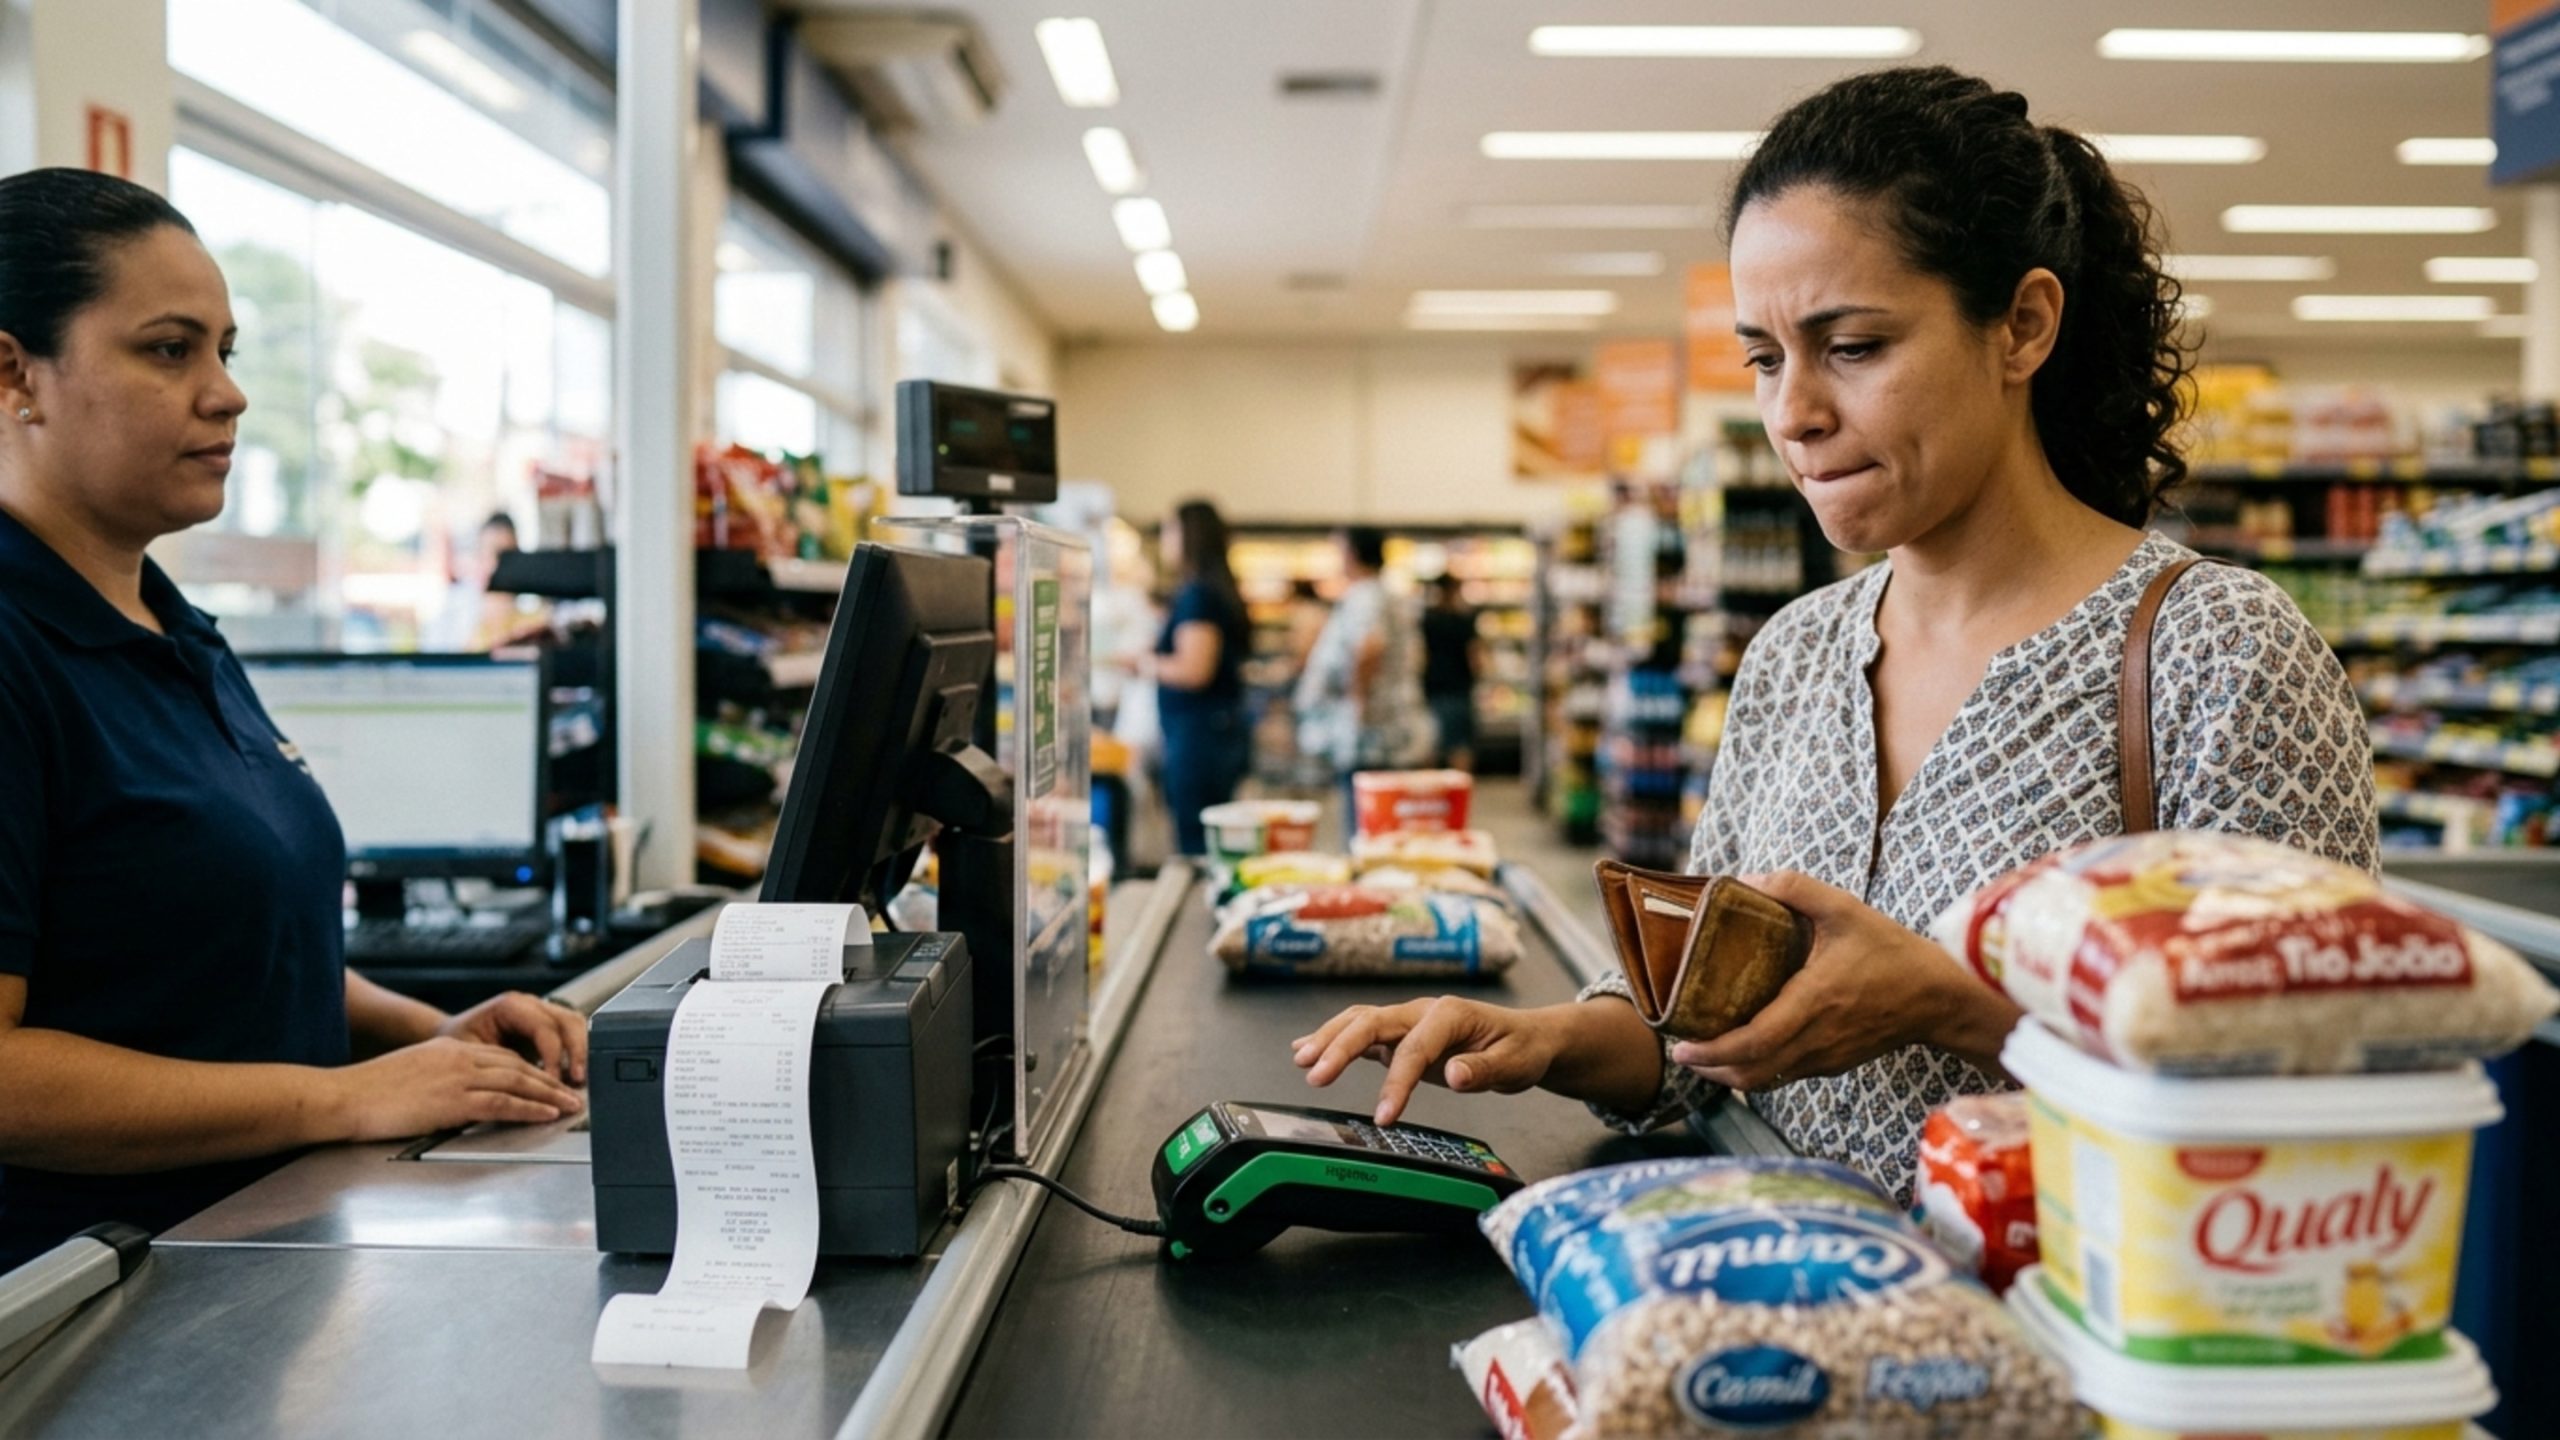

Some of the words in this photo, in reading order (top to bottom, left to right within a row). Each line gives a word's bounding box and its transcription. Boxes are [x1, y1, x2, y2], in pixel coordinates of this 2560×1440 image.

[2276, 935, 2349, 984] Tio
[2353, 932, 2466, 980] João
[2194, 1163, 2438, 1274] Qualy
[1656, 1232, 1908, 1288] Camil
[1692, 1361, 1819, 1408] Camil
